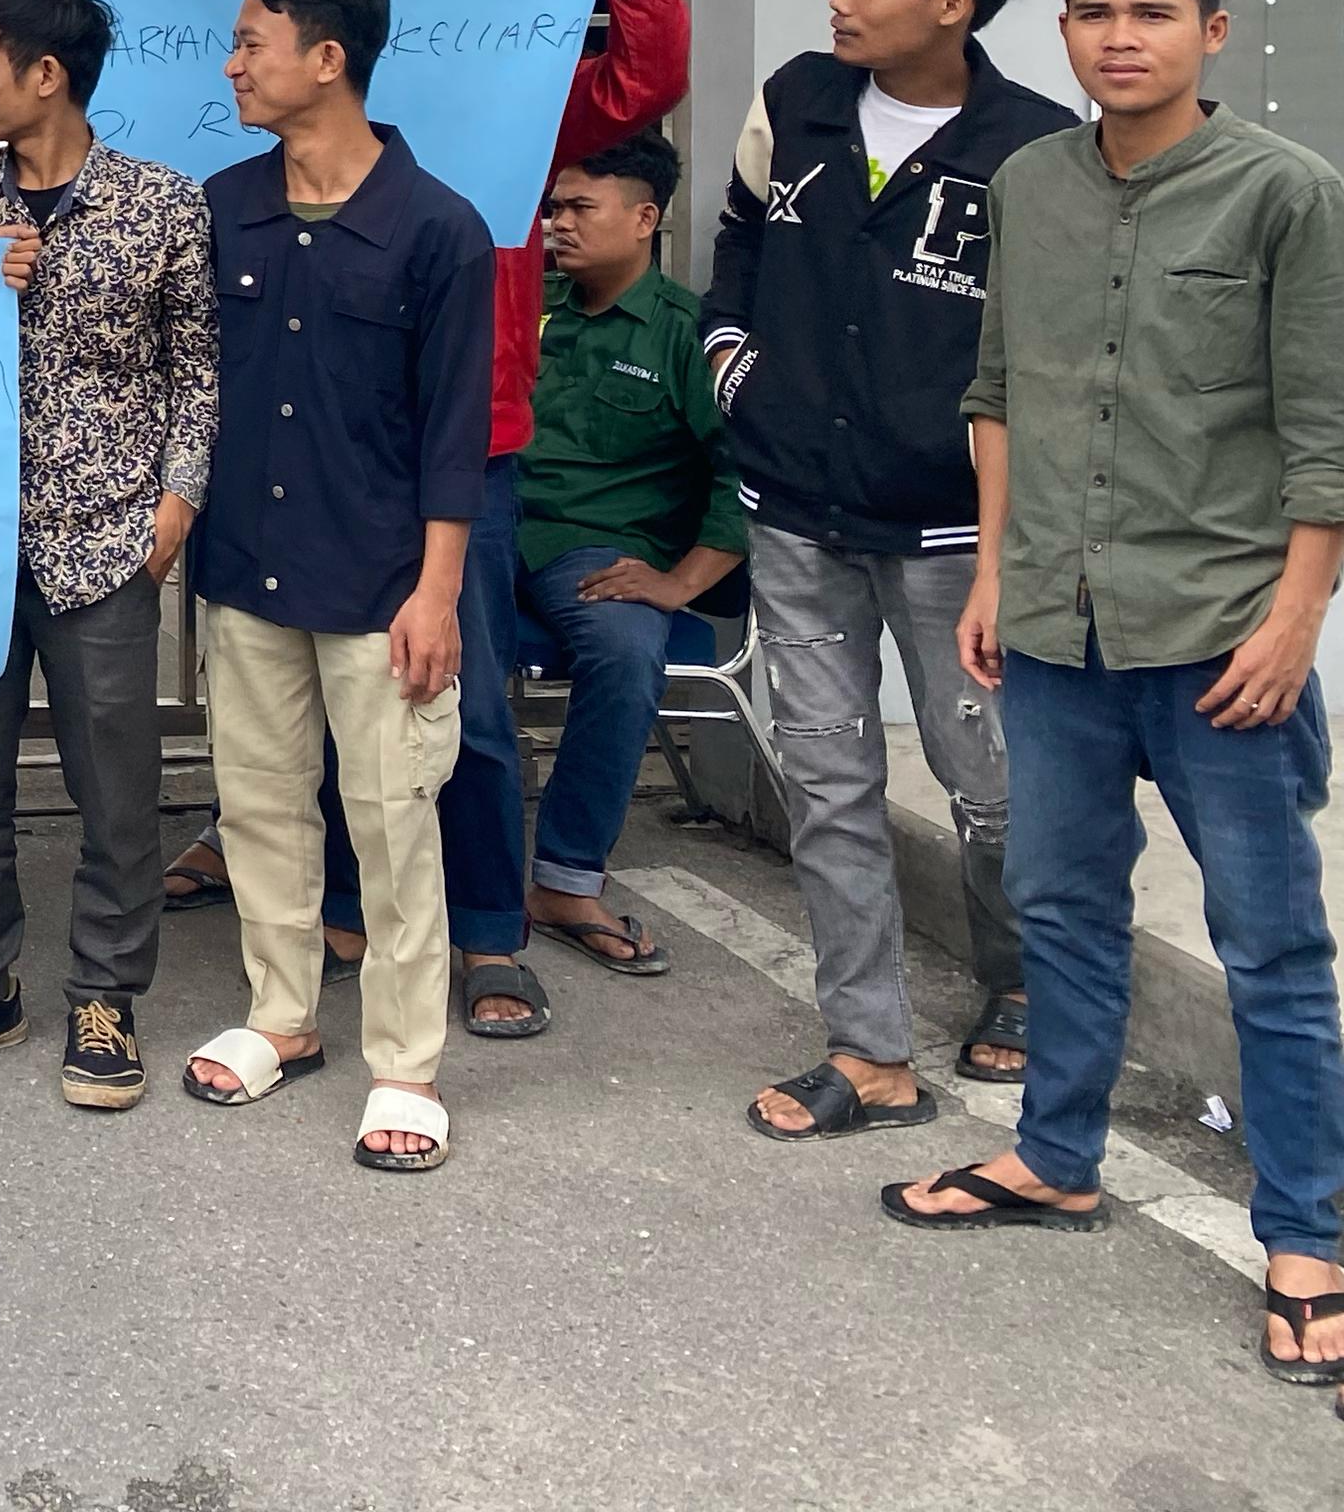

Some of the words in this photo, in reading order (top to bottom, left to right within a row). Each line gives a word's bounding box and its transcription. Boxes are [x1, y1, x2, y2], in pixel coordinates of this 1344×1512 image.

[892, 268, 941, 289] PLATINUM
[941, 280, 970, 295] SINCE
[916, 262, 946, 279] STAY
[948, 270, 976, 286] TRUE
